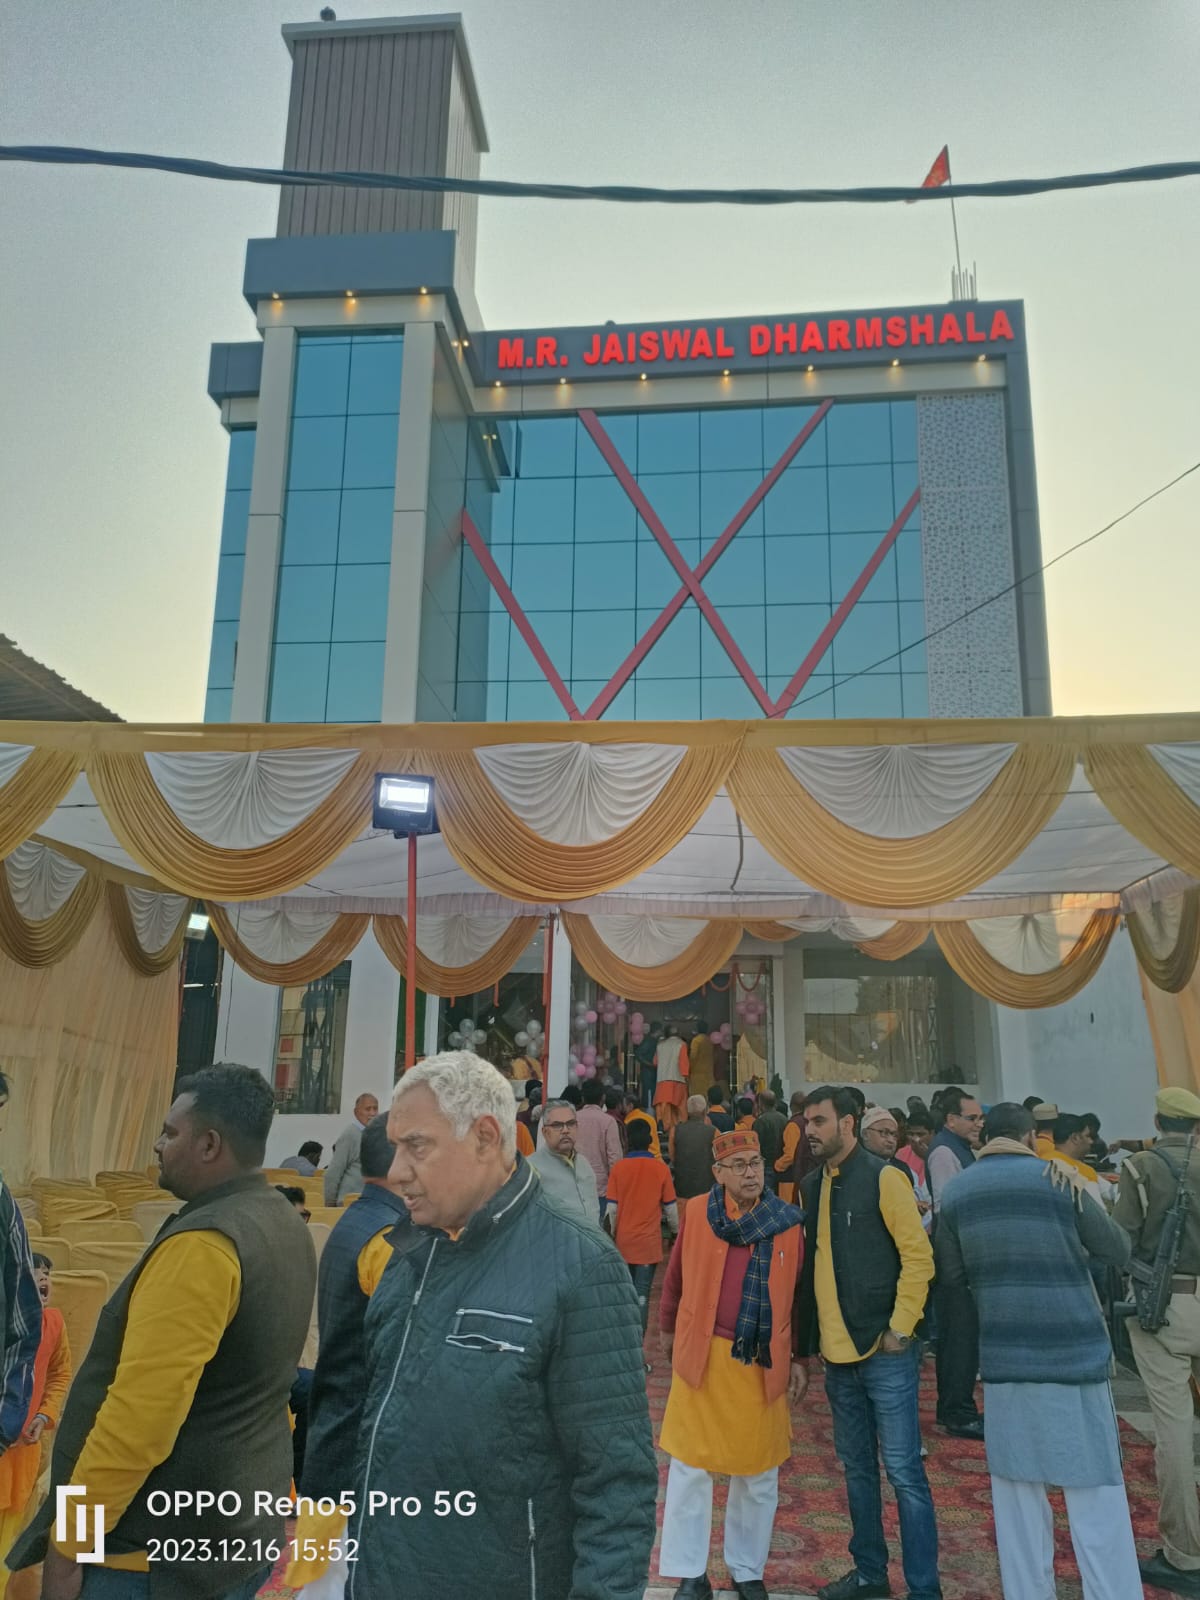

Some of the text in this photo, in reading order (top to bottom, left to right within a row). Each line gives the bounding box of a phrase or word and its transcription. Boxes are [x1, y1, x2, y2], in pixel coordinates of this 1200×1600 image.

[498, 311, 1014, 369] M.R. JAISWAL DHARMSHALA
